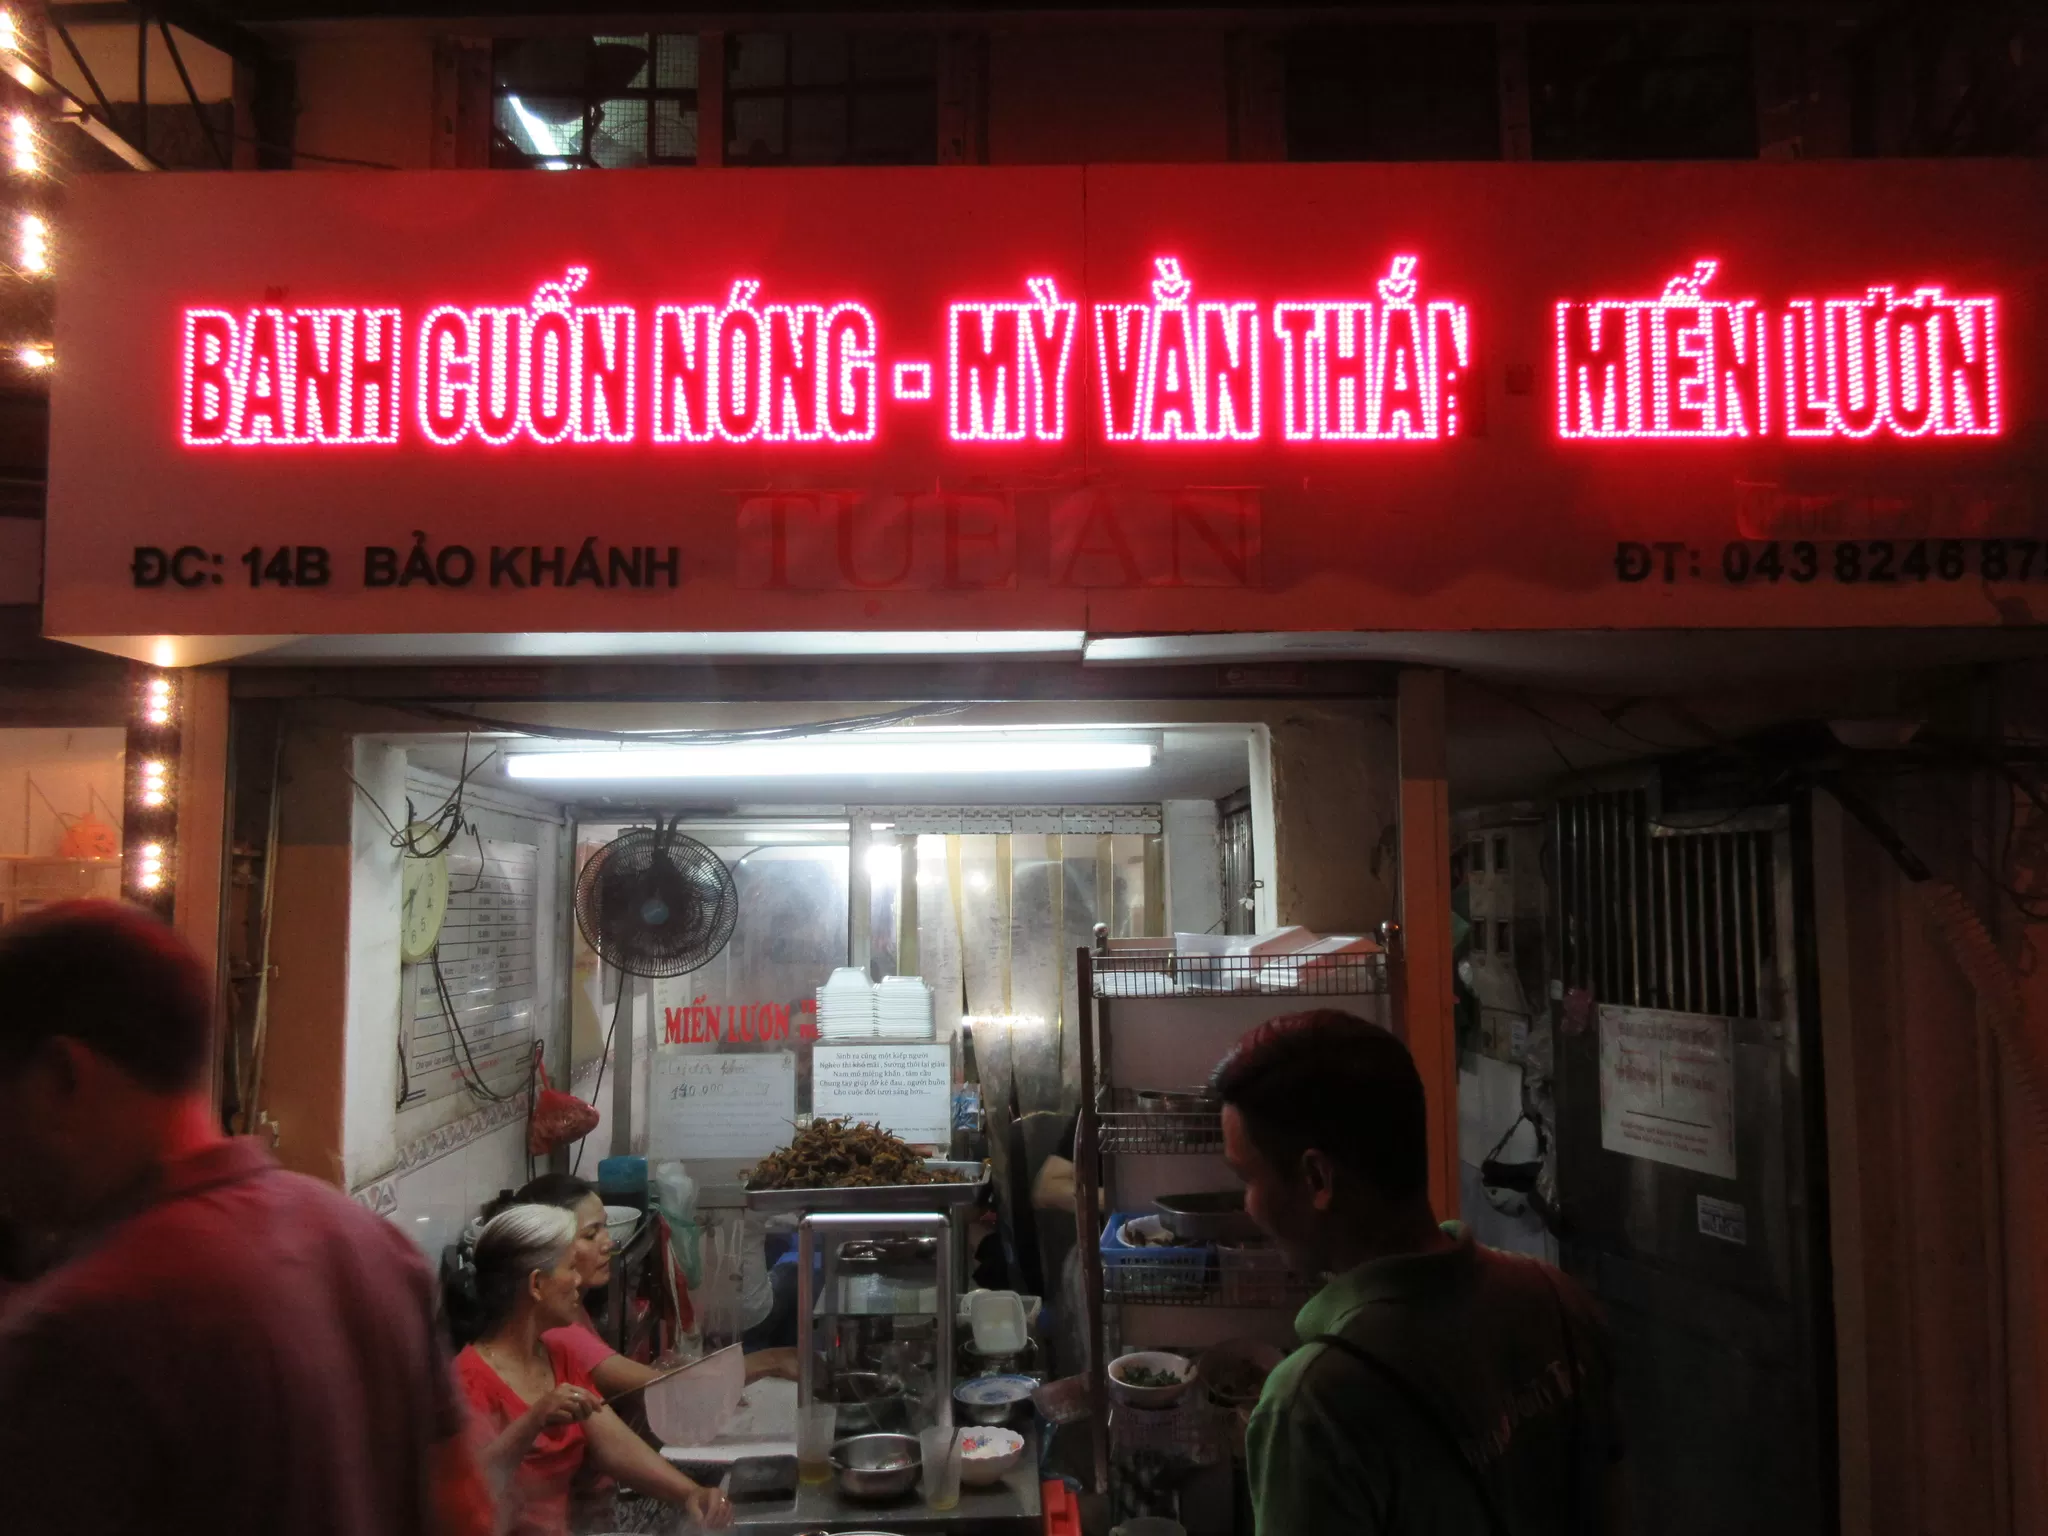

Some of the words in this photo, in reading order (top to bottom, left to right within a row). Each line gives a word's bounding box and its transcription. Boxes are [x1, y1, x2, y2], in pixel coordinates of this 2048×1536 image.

[419, 266, 636, 444] CUỐN
[652, 280, 877, 443] NÓNG
[949, 277, 1077, 440] MỲ
[1095, 257, 1260, 440] VẰN
[1556, 260, 1769, 438] MIẾN
[1783, 286, 2001, 437] LƯƠN
[131, 545, 224, 587] ĐC:
[241, 545, 331, 587] 14B
[364, 530, 475, 588] BẢO
[489, 536, 680, 588] KHÁNH
[1614, 541, 1700, 583] ĐT:
[1721, 541, 1819, 584] 043
[1834, 541, 1967, 584] 8246
[1978, 540, 2048, 582] 87
